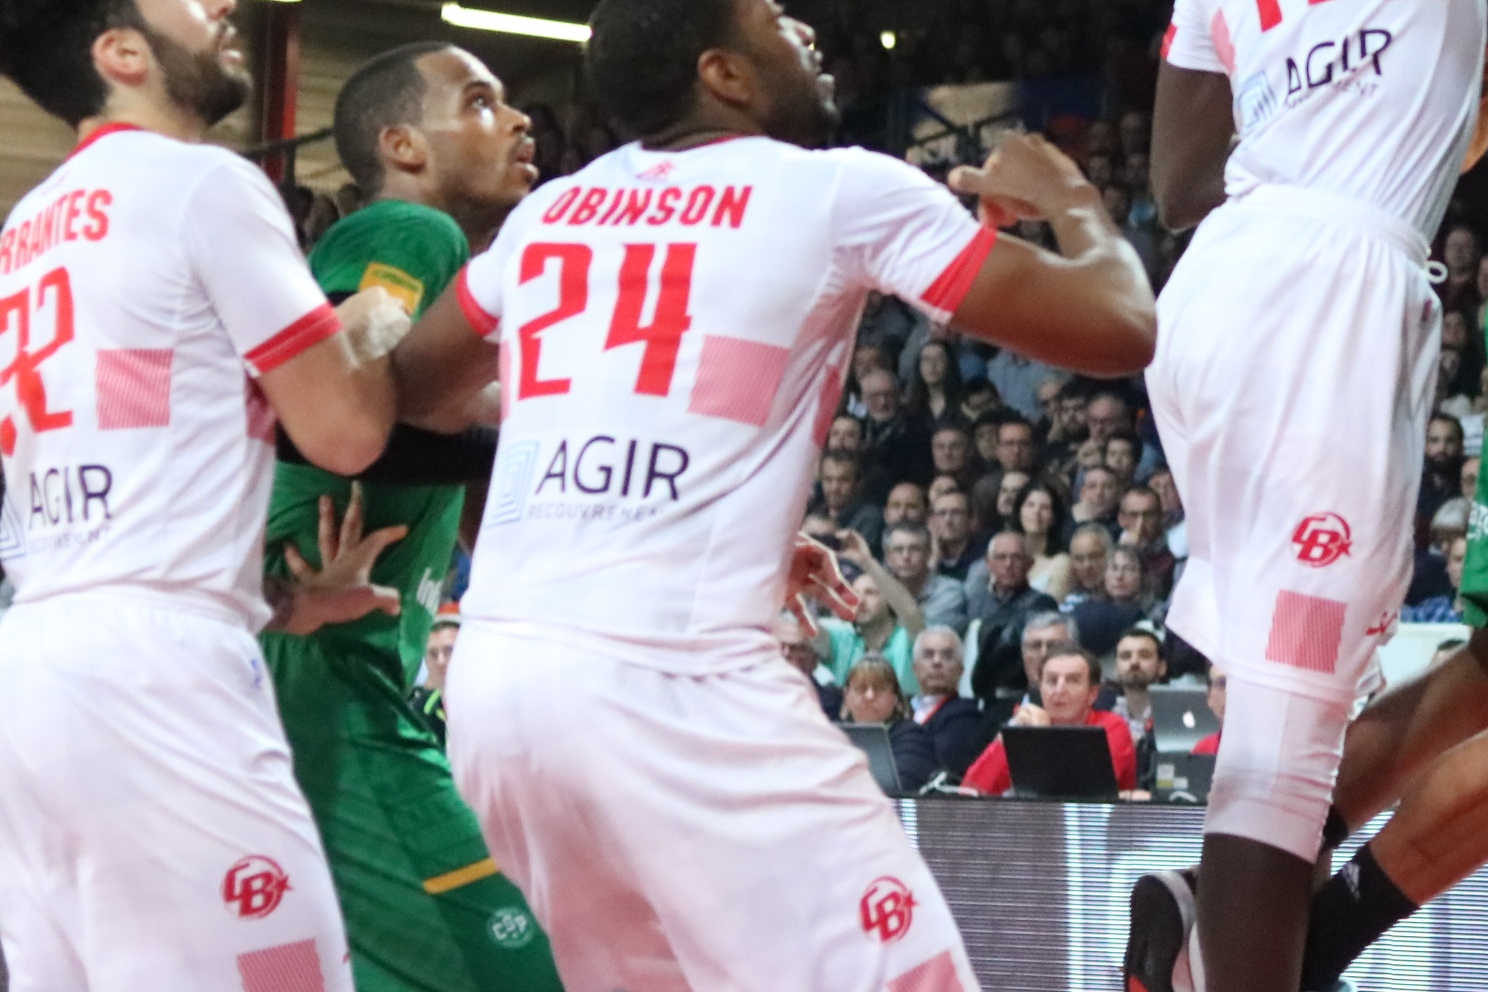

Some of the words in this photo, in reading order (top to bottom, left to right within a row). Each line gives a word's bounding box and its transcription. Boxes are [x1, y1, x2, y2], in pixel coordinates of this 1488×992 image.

[1284, 28, 1392, 95] AGIR
[518, 242, 698, 401] 24
[29, 464, 113, 530] AGIR
[535, 435, 690, 501] AGIR
